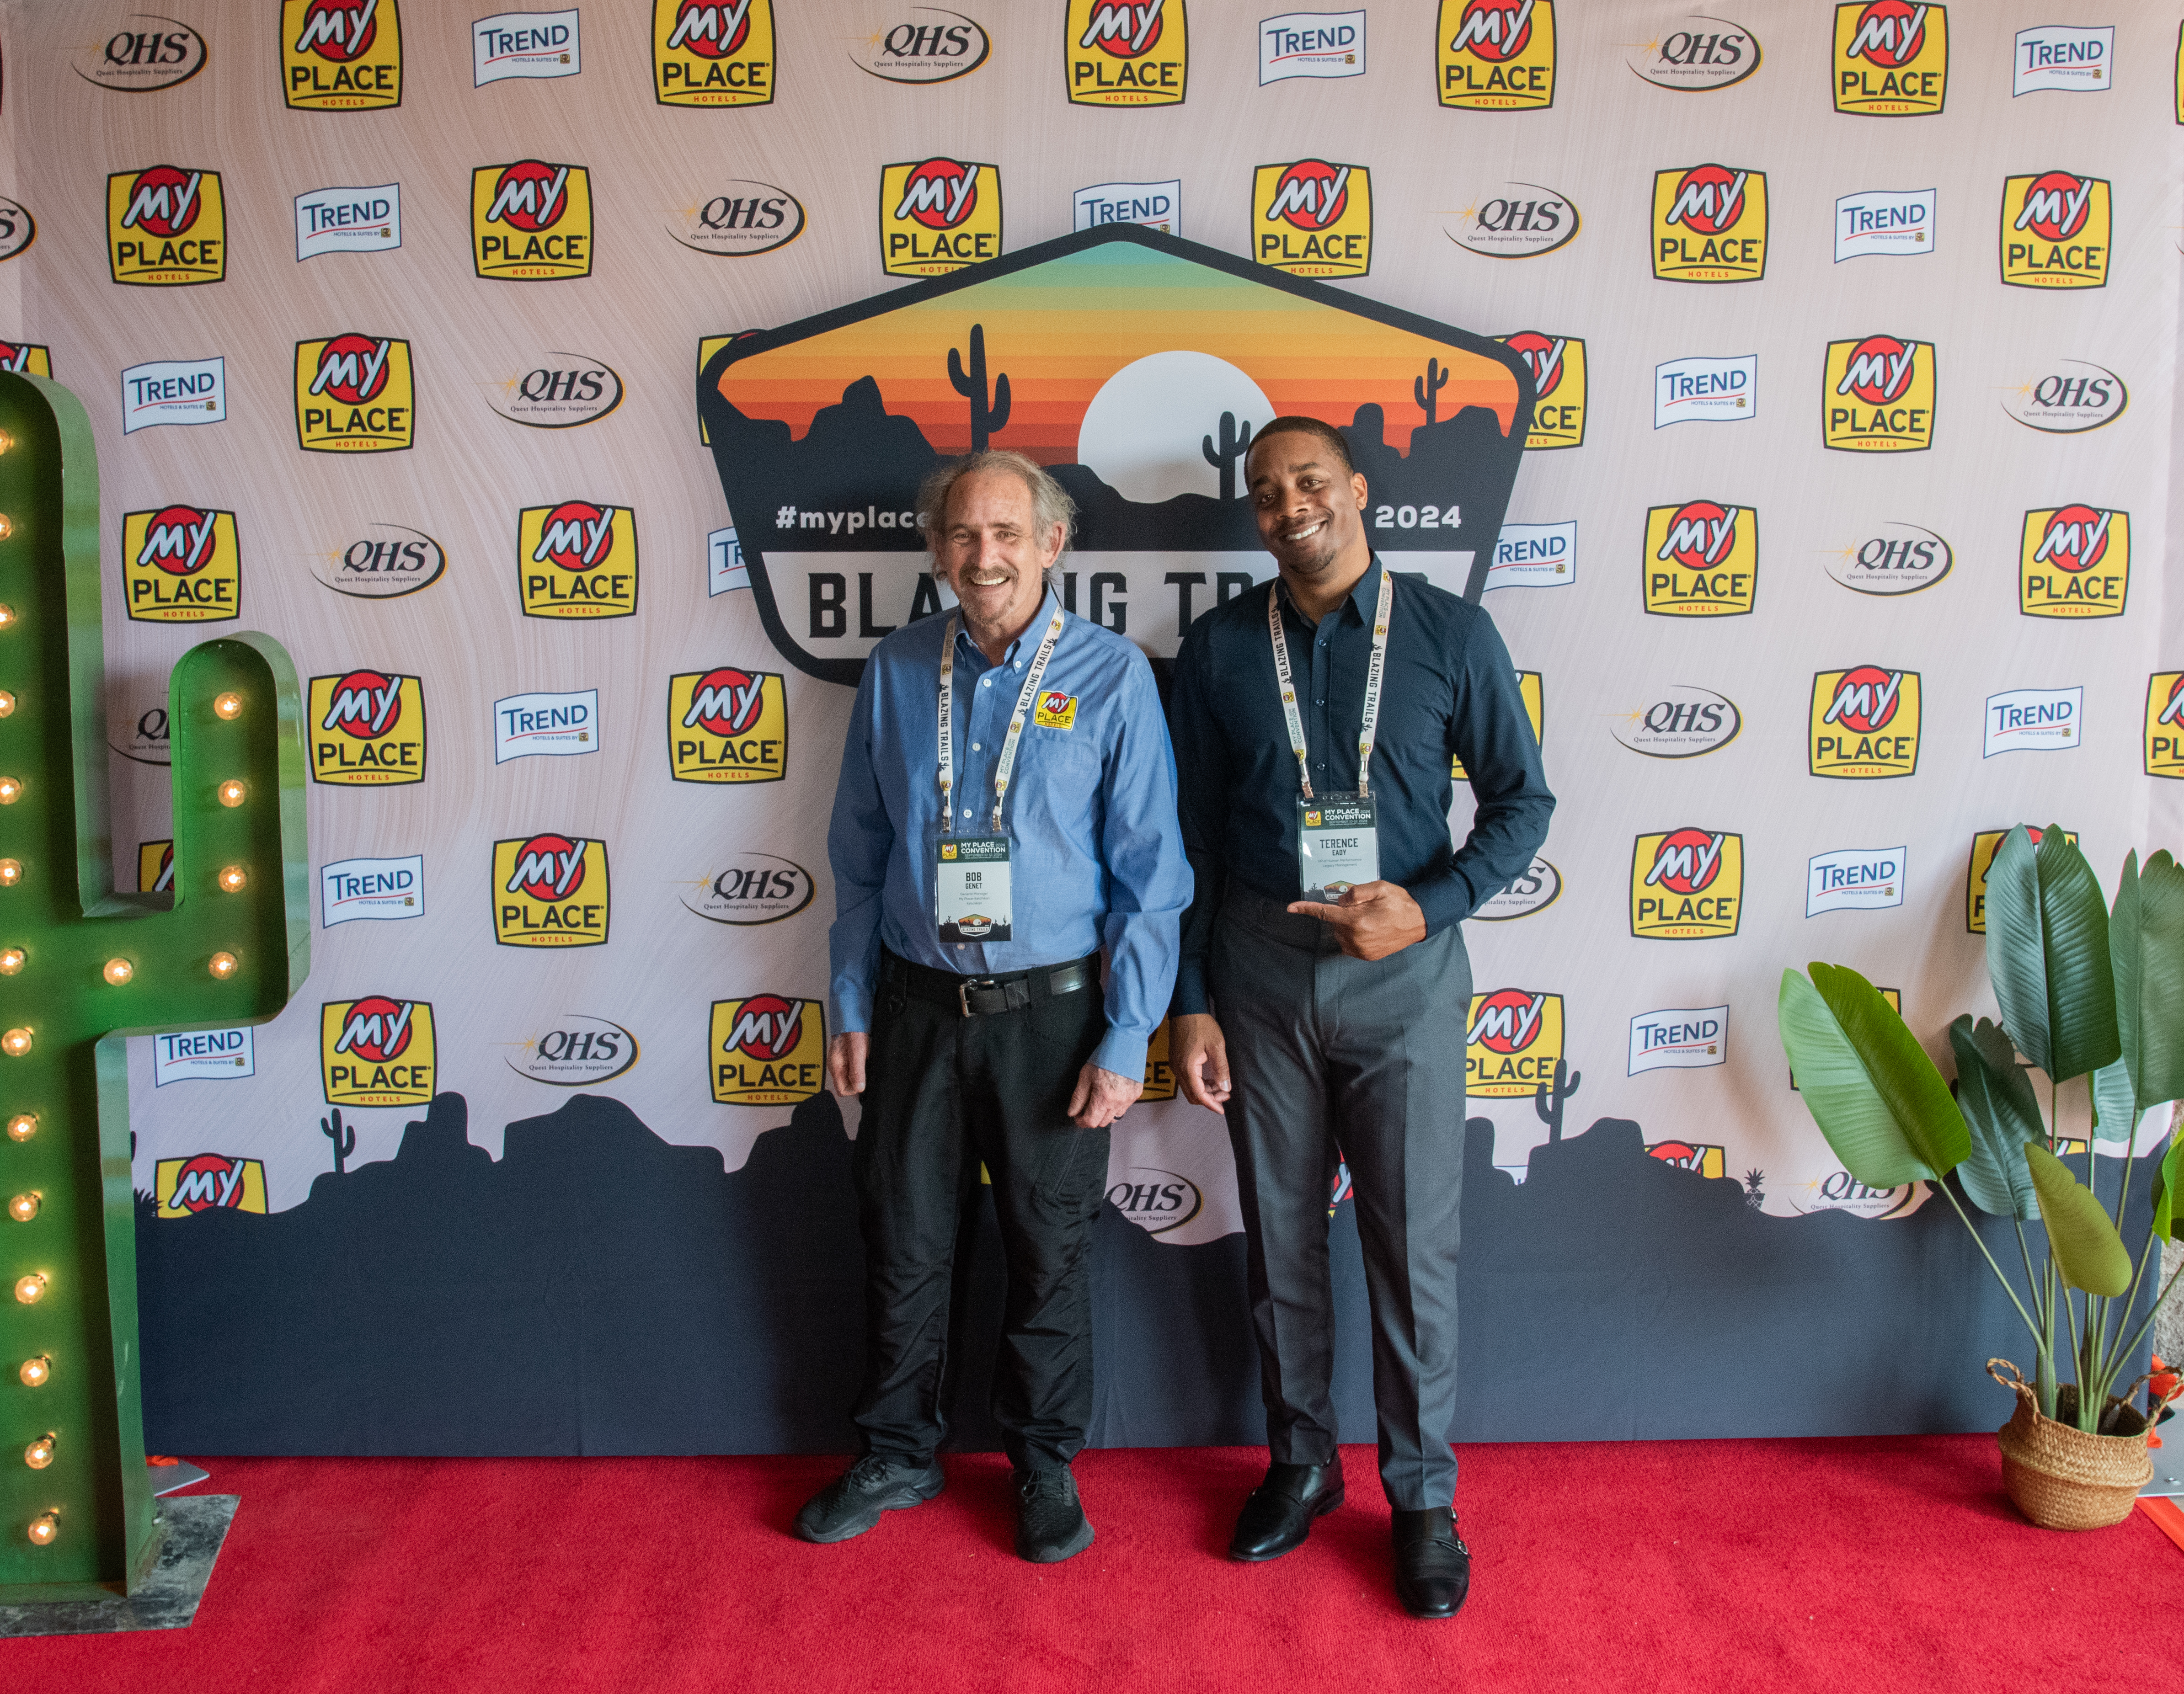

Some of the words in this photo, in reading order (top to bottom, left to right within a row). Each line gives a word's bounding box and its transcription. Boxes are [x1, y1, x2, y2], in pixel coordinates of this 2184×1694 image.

[104, 32, 189, 65] QHS
[480, 25, 568, 57] TREND
[882, 25, 972, 57] QHS
[1266, 26, 1355, 56] TREND
[1659, 32, 1745, 64] QHS
[2022, 40, 2104, 68] TREND
[291, 65, 393, 91] PLACE
[662, 62, 766, 87] PLACE
[1075, 62, 1178, 86] PLACE
[1446, 65, 1546, 91] PLACE
[1842, 71, 1940, 96] PLACE
[302, 199, 389, 231] TREND
[699, 197, 787, 229] QHS
[1081, 196, 1169, 229] TREND
[1476, 199, 1563, 231] QHS
[1842, 204, 1925, 234] TREND
[117, 240, 220, 266] PLACE
[482, 235, 583, 260] PLACE
[890, 233, 993, 257] PLACE
[1261, 234, 1362, 259] PLACE
[1661, 238, 1760, 263] PLACE
[2009, 244, 2103, 270] PLACE
[129, 373, 214, 405] TREND
[518, 370, 605, 402] QHS
[1662, 370, 1746, 400] TREND
[2032, 376, 2112, 407] QHS
[305, 408, 405, 432] PLACE
[1832, 408, 1928, 432] PLACE
[1375, 506, 1461, 528] 2024
[343, 541, 428, 572] QHS
[1855, 539, 1937, 570] QHS
[133, 578, 232, 603] PLACE
[529, 575, 629, 599] PLACE
[1652, 574, 1750, 597] PLACE
[2028, 576, 2121, 599] PLACE
[1272, 614, 1283, 641] TRAILS
[1276, 643, 1289, 677] BLAZING
[1370, 653, 1381, 687] BLAZING
[1020, 673, 1039, 707] BLAZING
[1035, 645, 1052, 671] TRAILS
[501, 705, 587, 735] TREND
[940, 691, 949, 727] BLAZING
[1038, 712, 1071, 724] PLACE
[1365, 692, 1376, 723] TRAILS
[1642, 702, 1725, 733] QHS
[1993, 702, 2072, 730] TREND
[1292, 708, 1302, 743] CONVENTION
[318, 742, 417, 766] PLACE
[678, 740, 781, 764] PLACE
[940, 731, 949, 762] TRAILS
[1004, 740, 1015, 774] CONVENTION
[1817, 736, 1912, 759] PLACE
[1319, 838, 1358, 848] TERENCE
[328, 870, 412, 900] TREND
[712, 869, 798, 900] QHS
[966, 872, 981, 881] BOB
[1816, 862, 1896, 890] TREND
[502, 905, 600, 928] PLACE
[1639, 898, 1735, 921] PLACE
[160, 1032, 243, 1060] TREND
[537, 1031, 620, 1061] QHS
[1637, 1020, 1718, 1049] TREND
[331, 1065, 427, 1088] PLACE
[719, 1063, 819, 1087] PLACE
